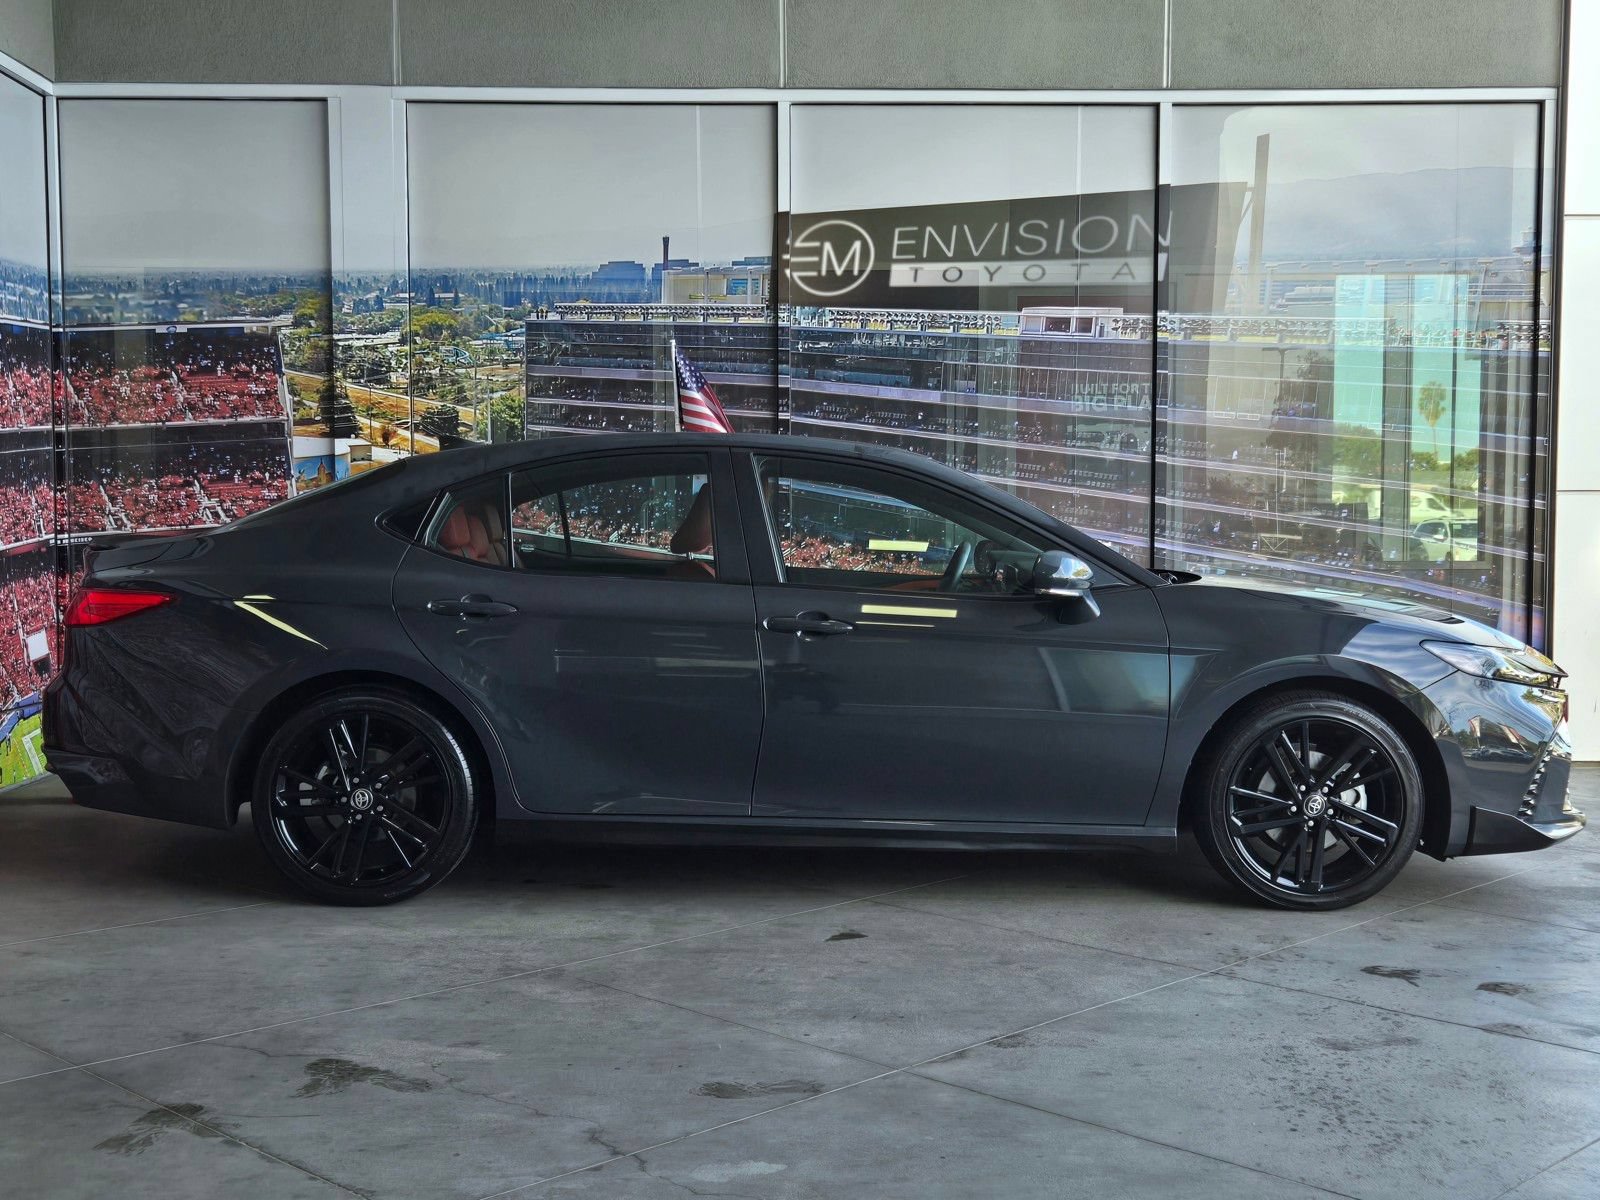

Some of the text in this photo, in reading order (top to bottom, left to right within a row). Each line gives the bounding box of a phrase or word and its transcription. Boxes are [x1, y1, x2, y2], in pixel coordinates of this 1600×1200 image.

[891, 210, 1173, 260] ENVISION
[908, 261, 1136, 283] TOYOTA
[1111, 383, 1139, 394] FOR
